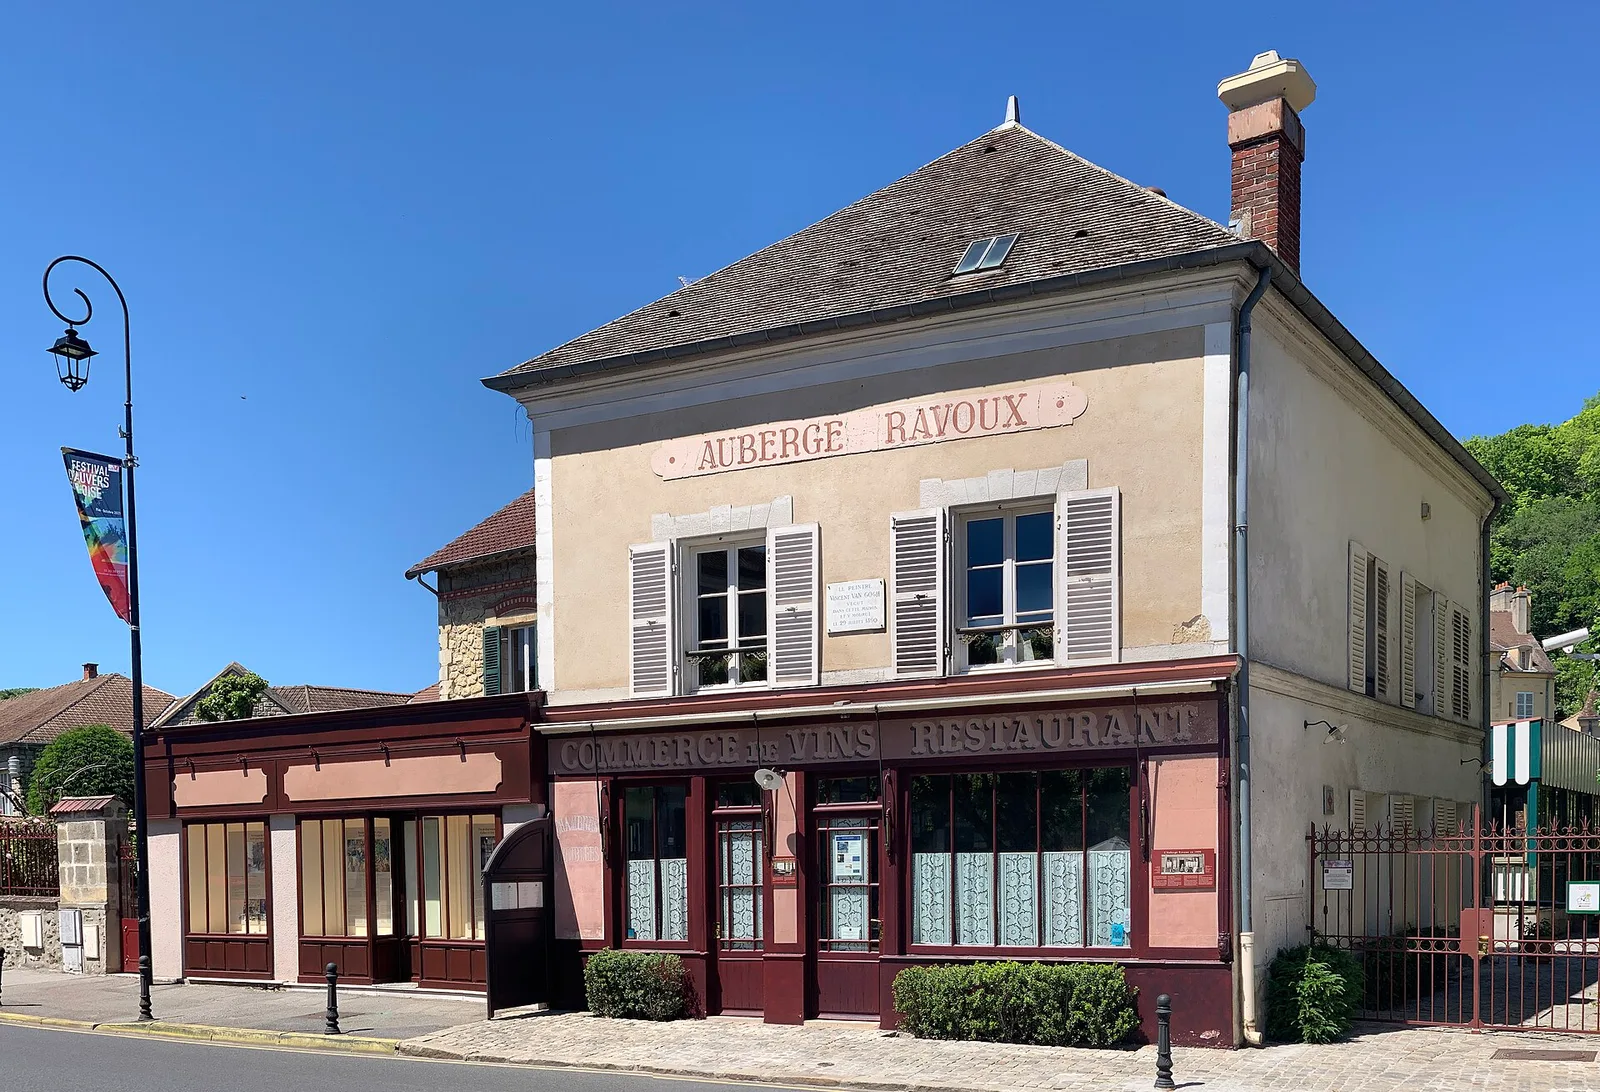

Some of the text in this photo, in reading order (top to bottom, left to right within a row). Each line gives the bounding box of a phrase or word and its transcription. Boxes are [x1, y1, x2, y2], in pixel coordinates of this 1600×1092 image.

[697, 392, 1028, 471] AUBERGE RAVOUX
[71, 459, 110, 477] FESTIVAL
[560, 731, 741, 772] COMMERCE
[785, 723, 876, 761] VINS
[909, 705, 1199, 756] RESTAURANT
